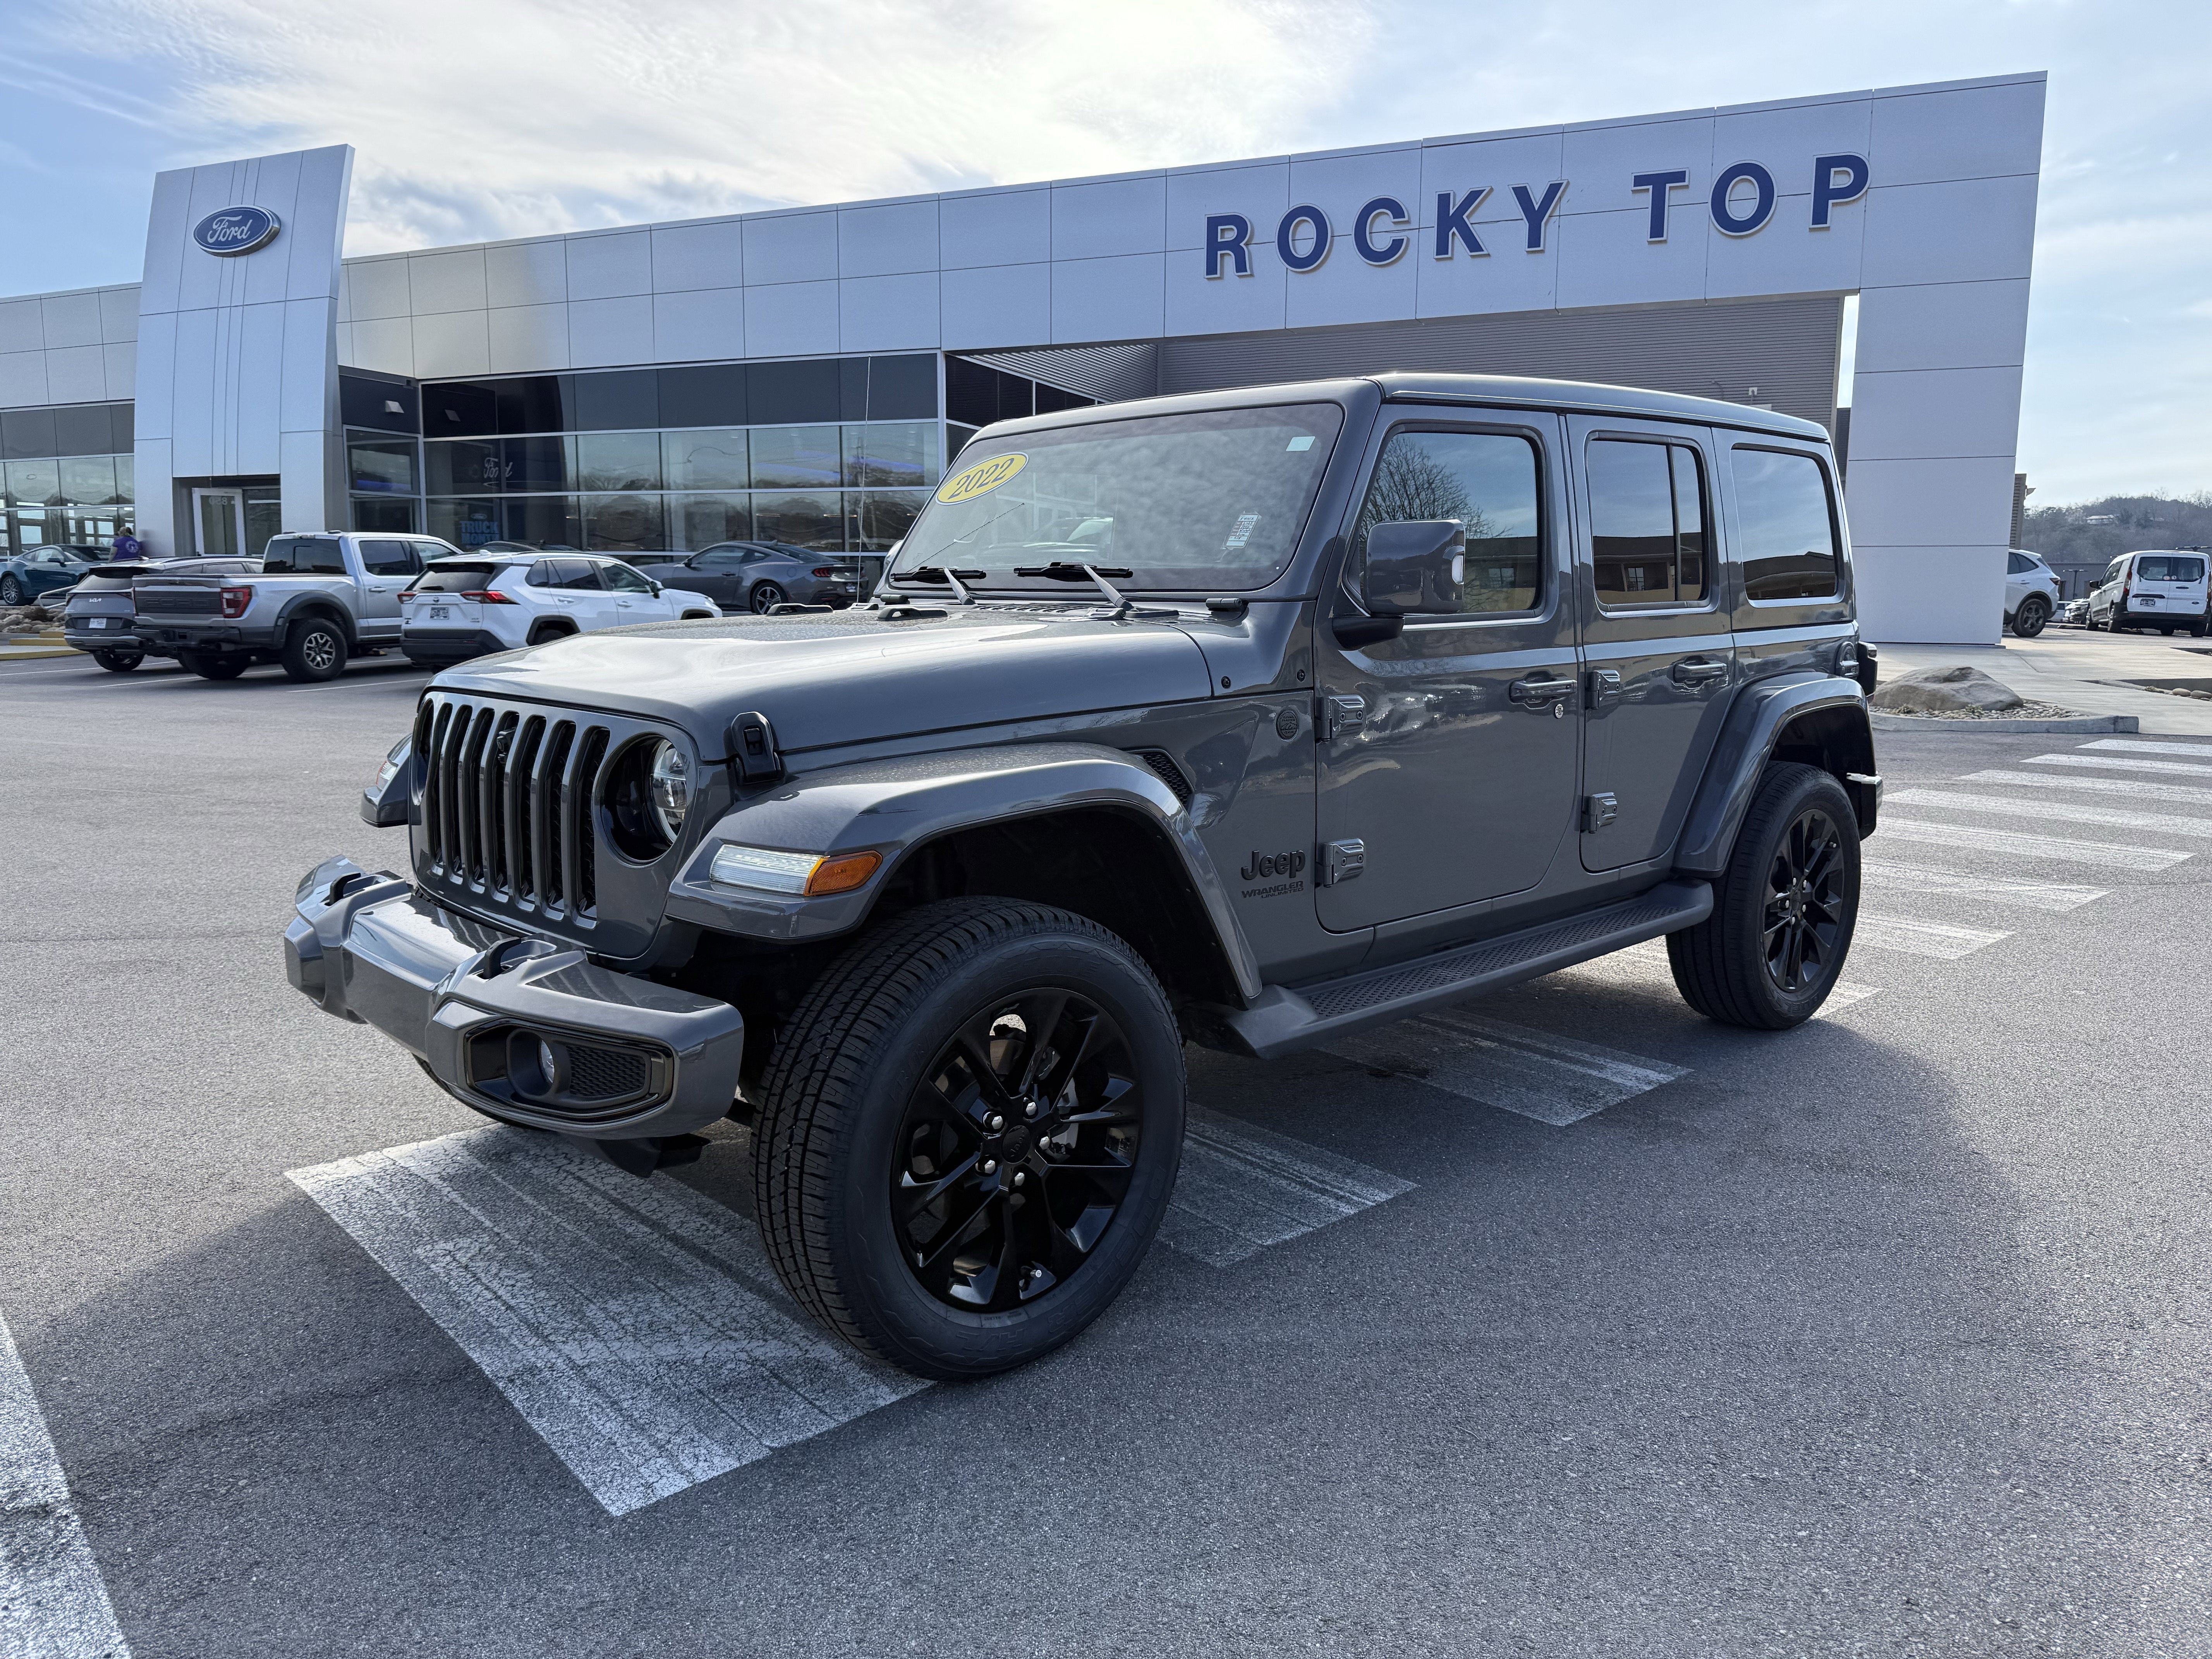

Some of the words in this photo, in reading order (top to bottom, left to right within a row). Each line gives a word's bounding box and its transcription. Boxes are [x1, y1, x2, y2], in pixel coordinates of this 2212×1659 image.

[207, 215, 253, 243] Ford
[1205, 180, 1566, 278] ROCKY
[1632, 153, 1870, 240] TOP
[948, 458, 1014, 500] 2022
[460, 520, 499, 533] TRUCK
[1241, 850, 1306, 880] Jeep
[1242, 881, 1304, 898] WRANGLER
[1261, 887, 1304, 899] UNLIMITED
